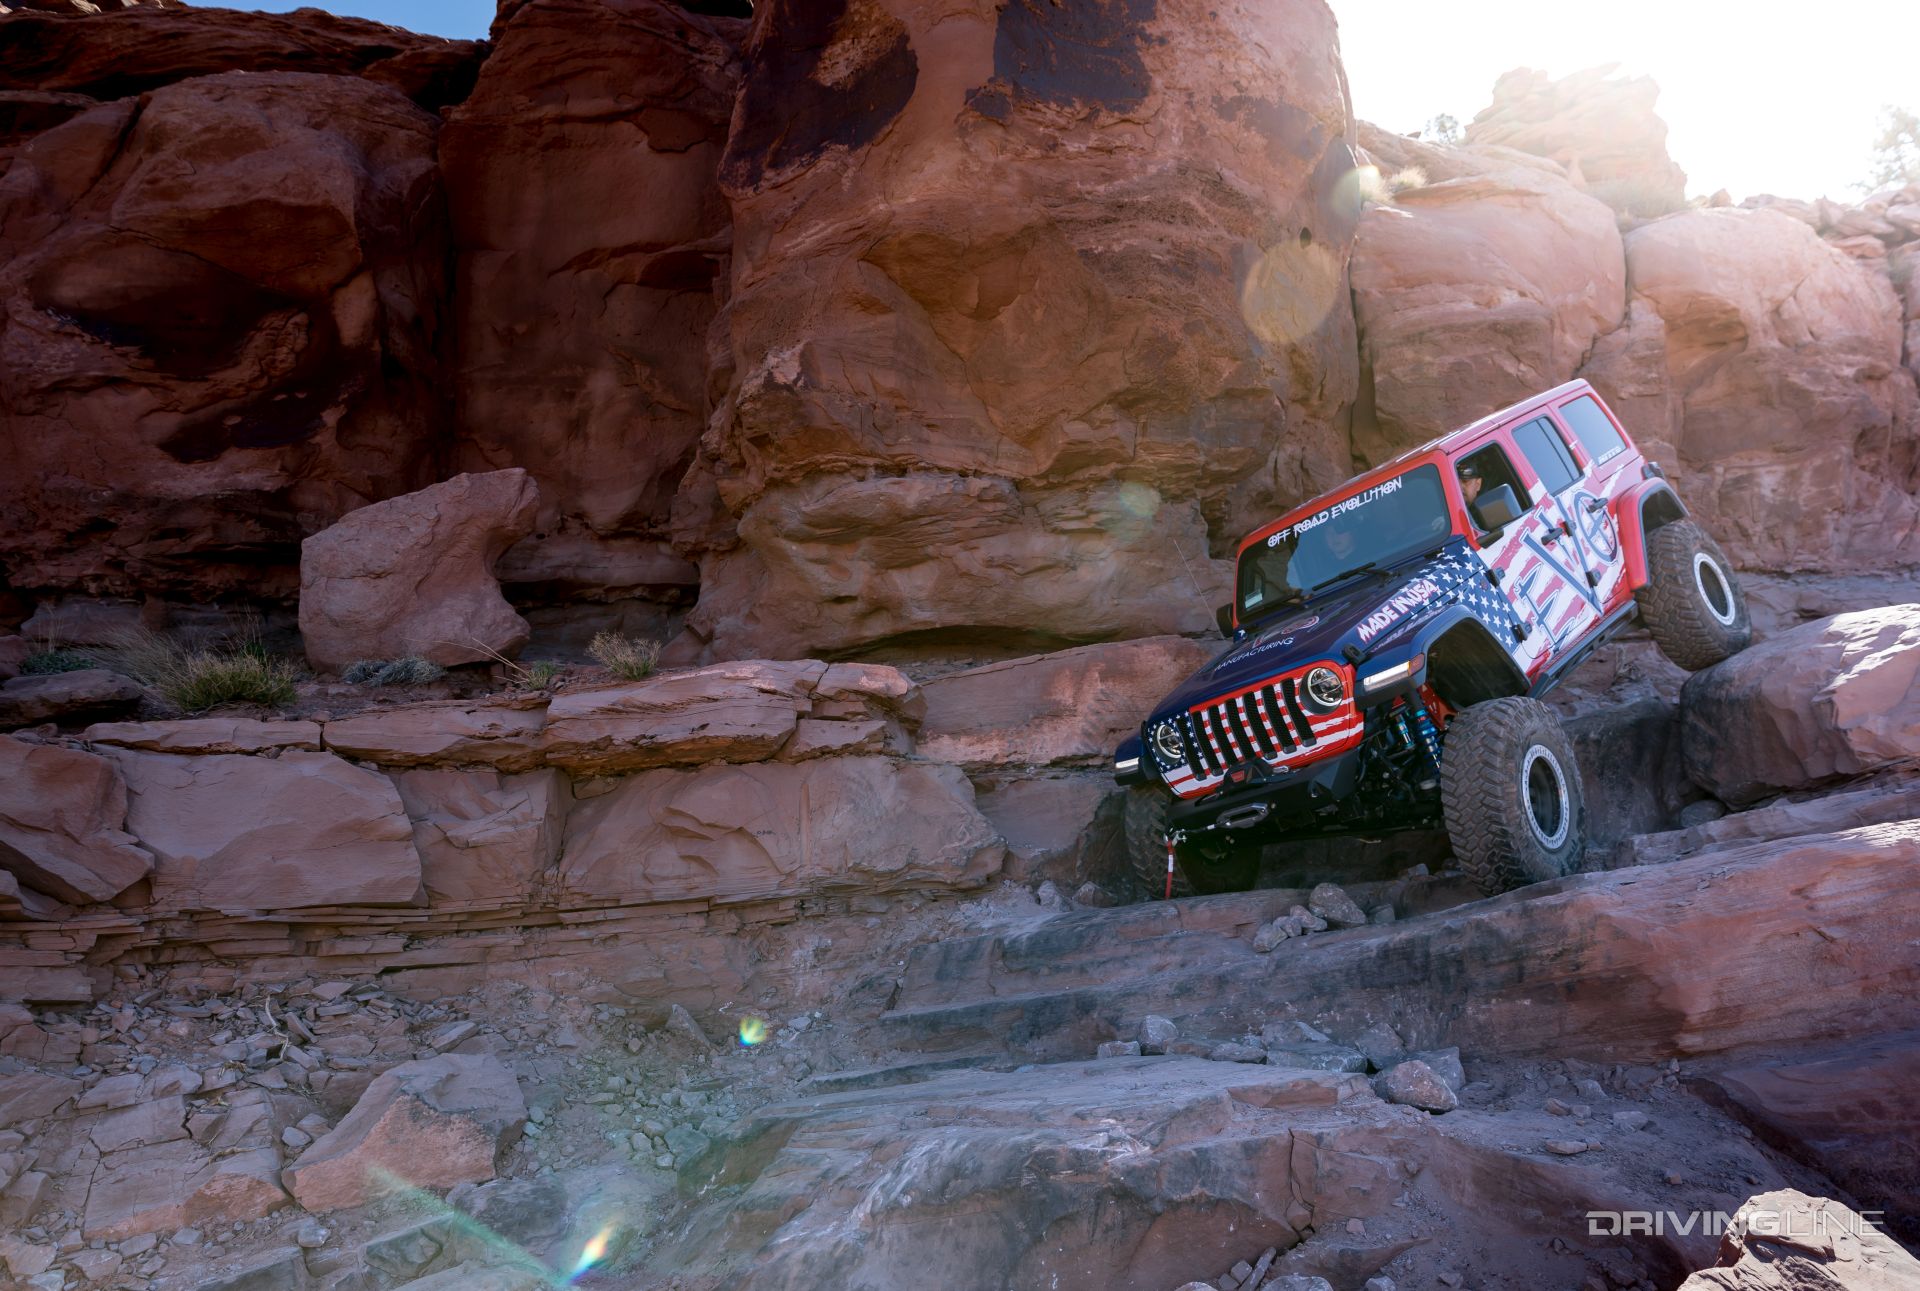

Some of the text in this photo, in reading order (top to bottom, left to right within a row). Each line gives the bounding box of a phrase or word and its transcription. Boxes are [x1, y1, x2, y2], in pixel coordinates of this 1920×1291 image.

[1267, 476, 1402, 548] OFF ROAD EVOLUTION
[1357, 606, 1400, 644] MADE
[1393, 595, 1412, 615] IN
[1409, 579, 1438, 606] USA
[1214, 636, 1295, 672] MANUFACTURING
